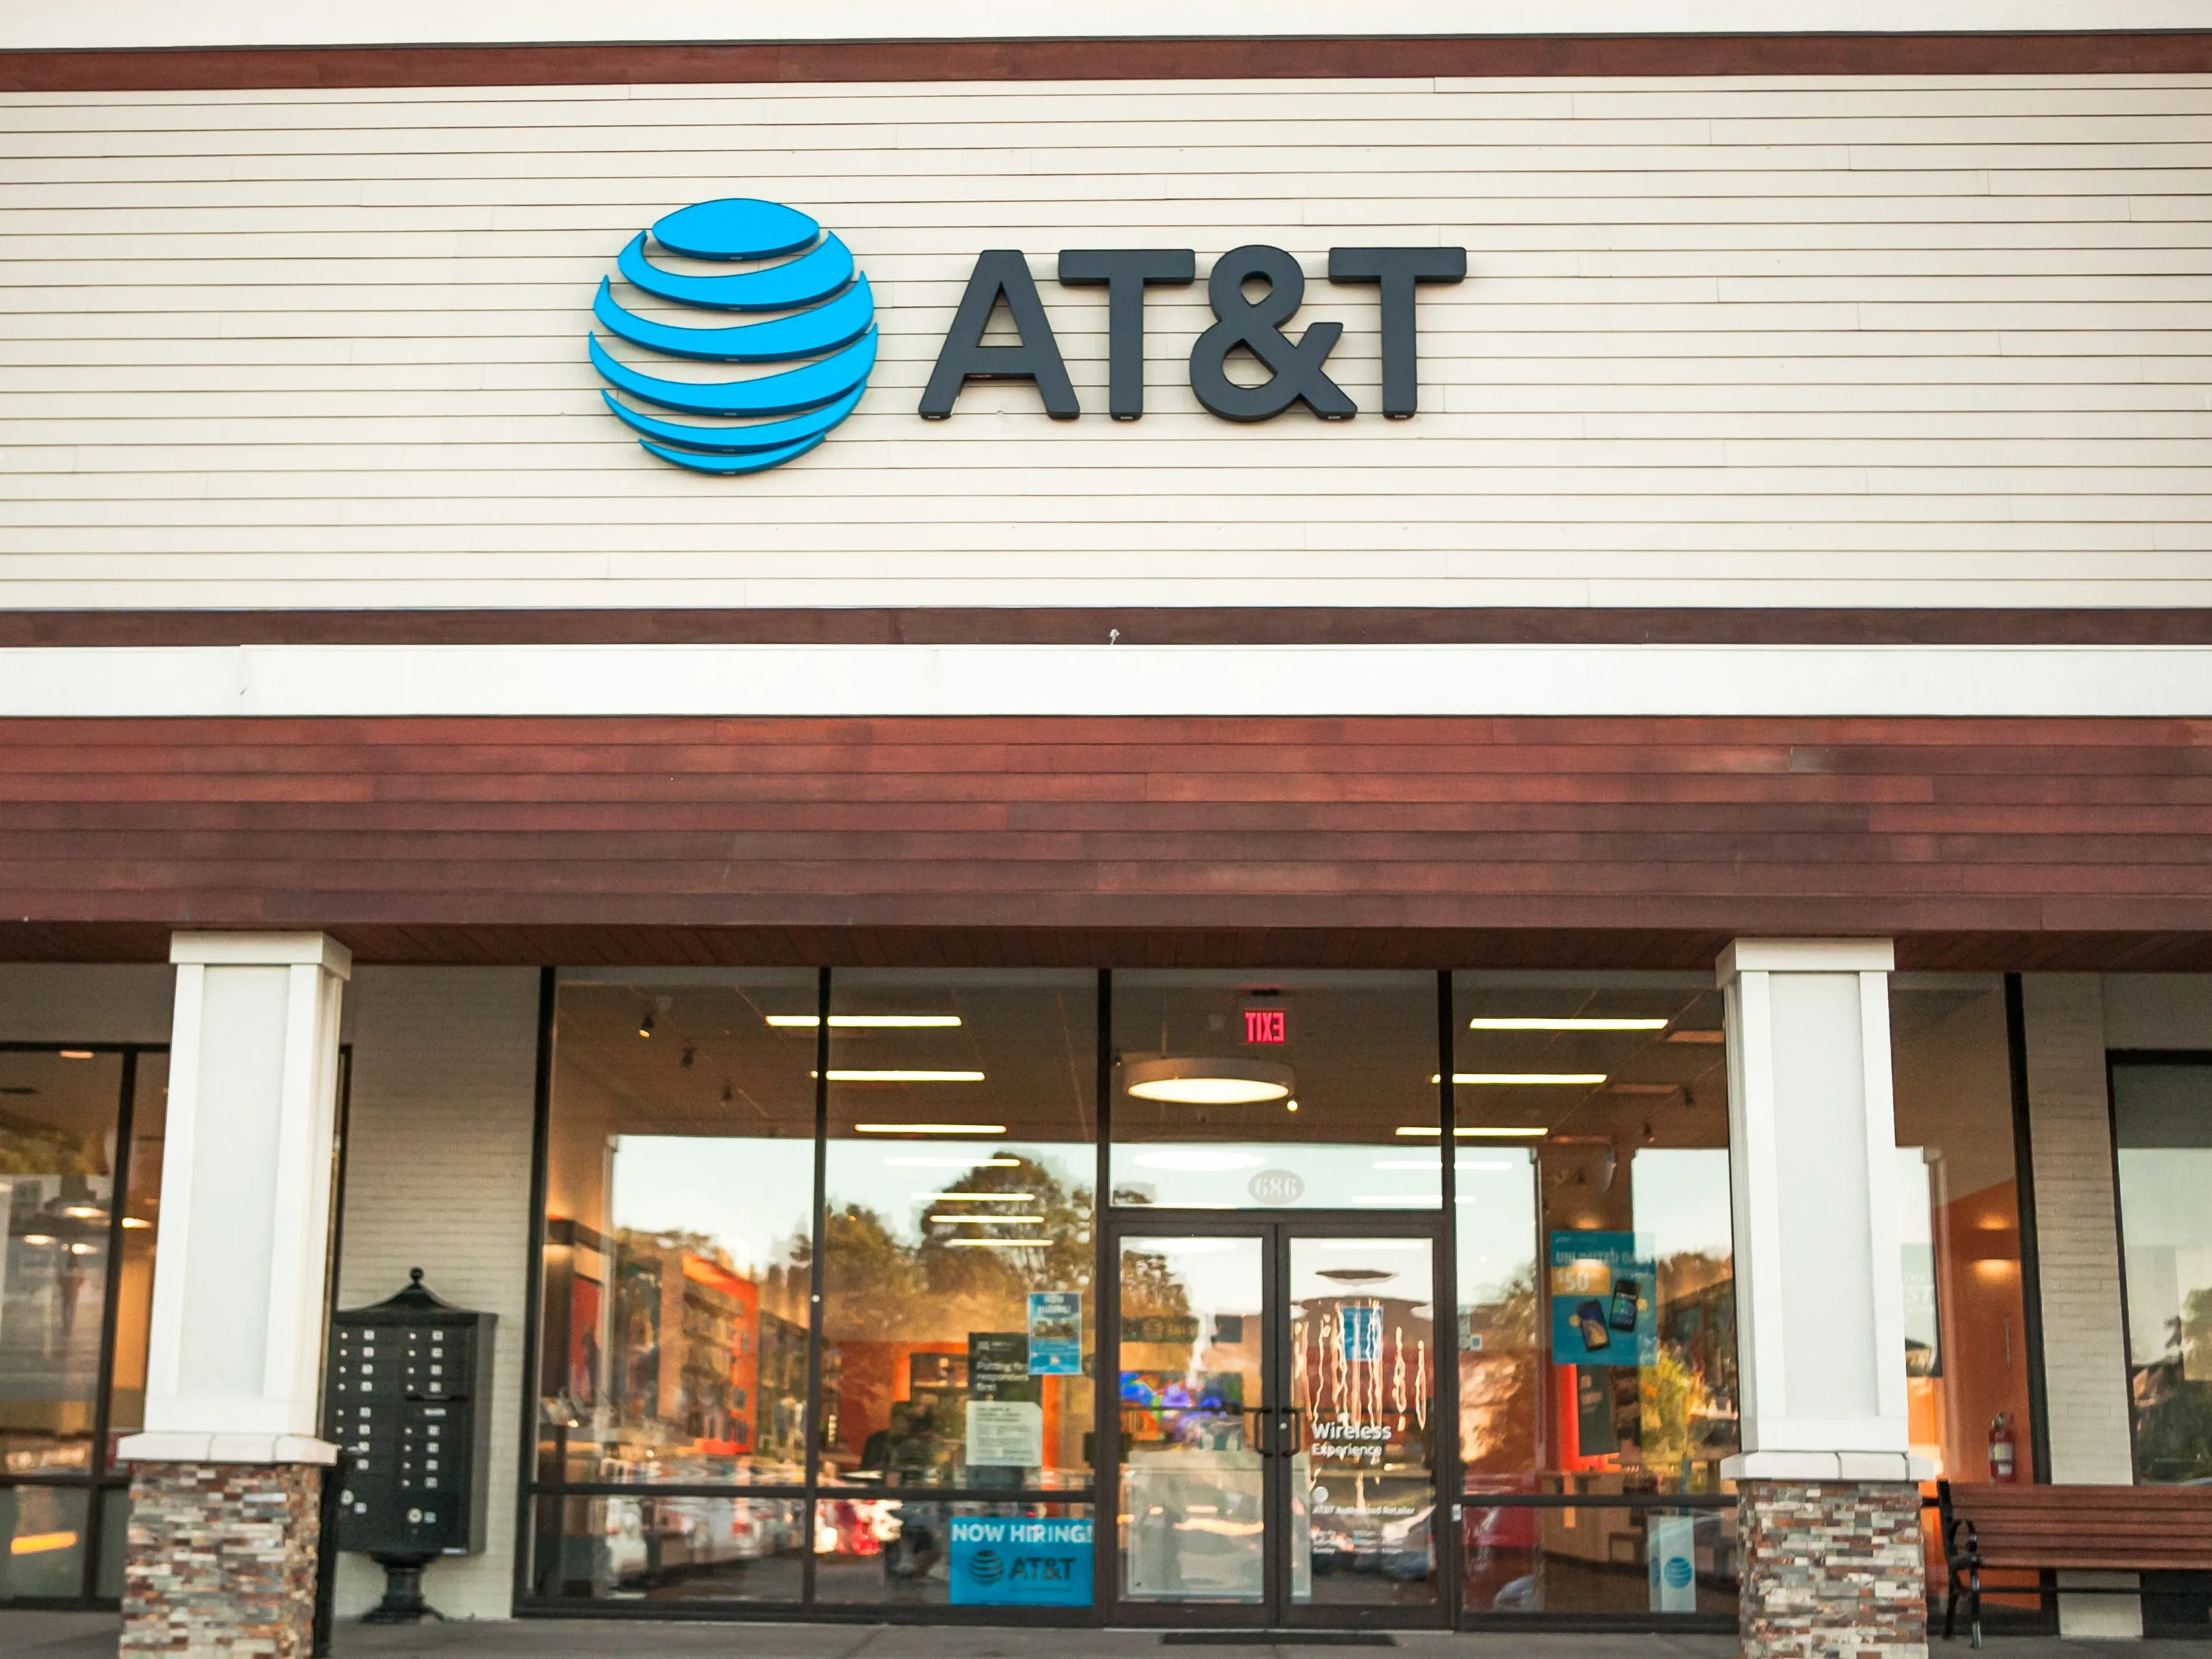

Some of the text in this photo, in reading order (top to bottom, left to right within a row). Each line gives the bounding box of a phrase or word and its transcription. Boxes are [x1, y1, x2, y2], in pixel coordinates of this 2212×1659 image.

[918, 245, 1467, 422] AT&T
[1255, 1177, 1297, 1198] 686
[1311, 1422, 1392, 1440] Wireless
[1311, 1443, 1383, 1458] Experience
[952, 1524, 1092, 1543] NOW HIRING!
[1009, 1557, 1075, 1581] AT&T
